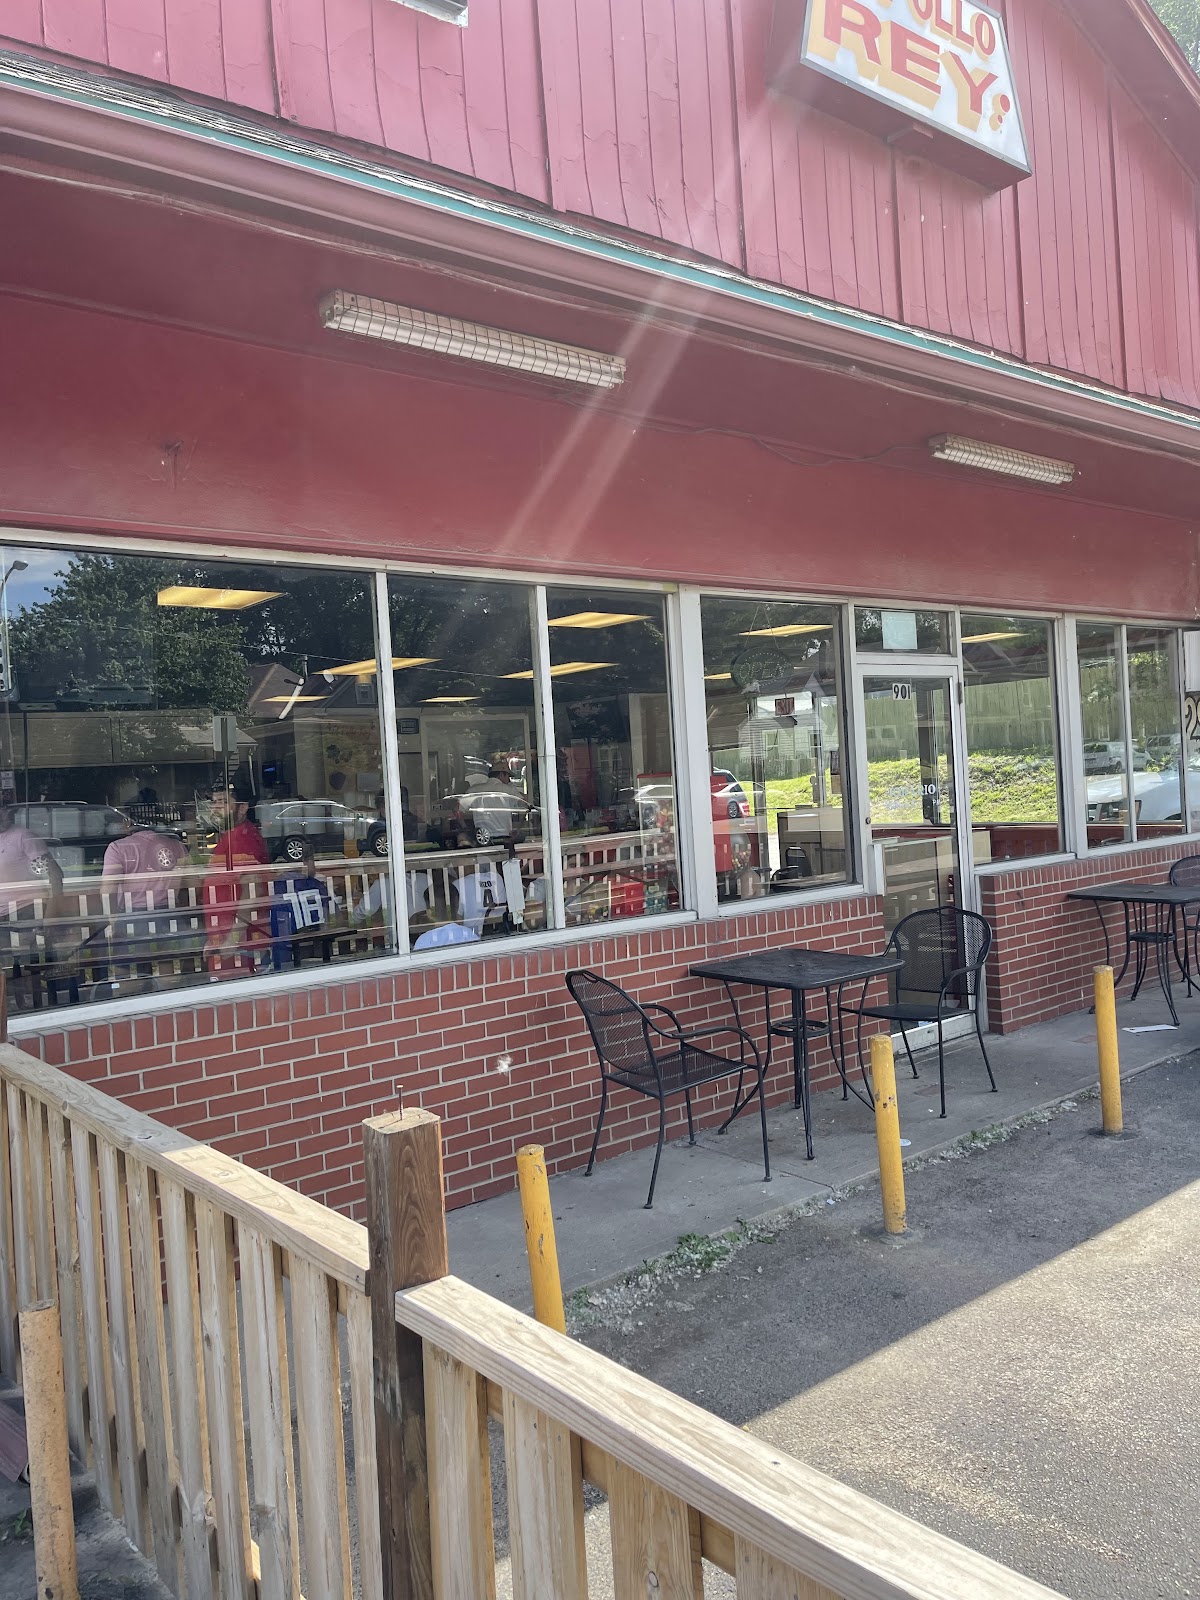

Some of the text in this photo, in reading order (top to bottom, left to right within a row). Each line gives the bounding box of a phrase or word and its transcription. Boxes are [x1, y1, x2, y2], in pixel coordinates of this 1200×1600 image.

[909, 0, 996, 57] OLLO
[816, 0, 999, 122] REY
[893, 684, 911, 700] 901
[1184, 696, 1200, 740] 2
